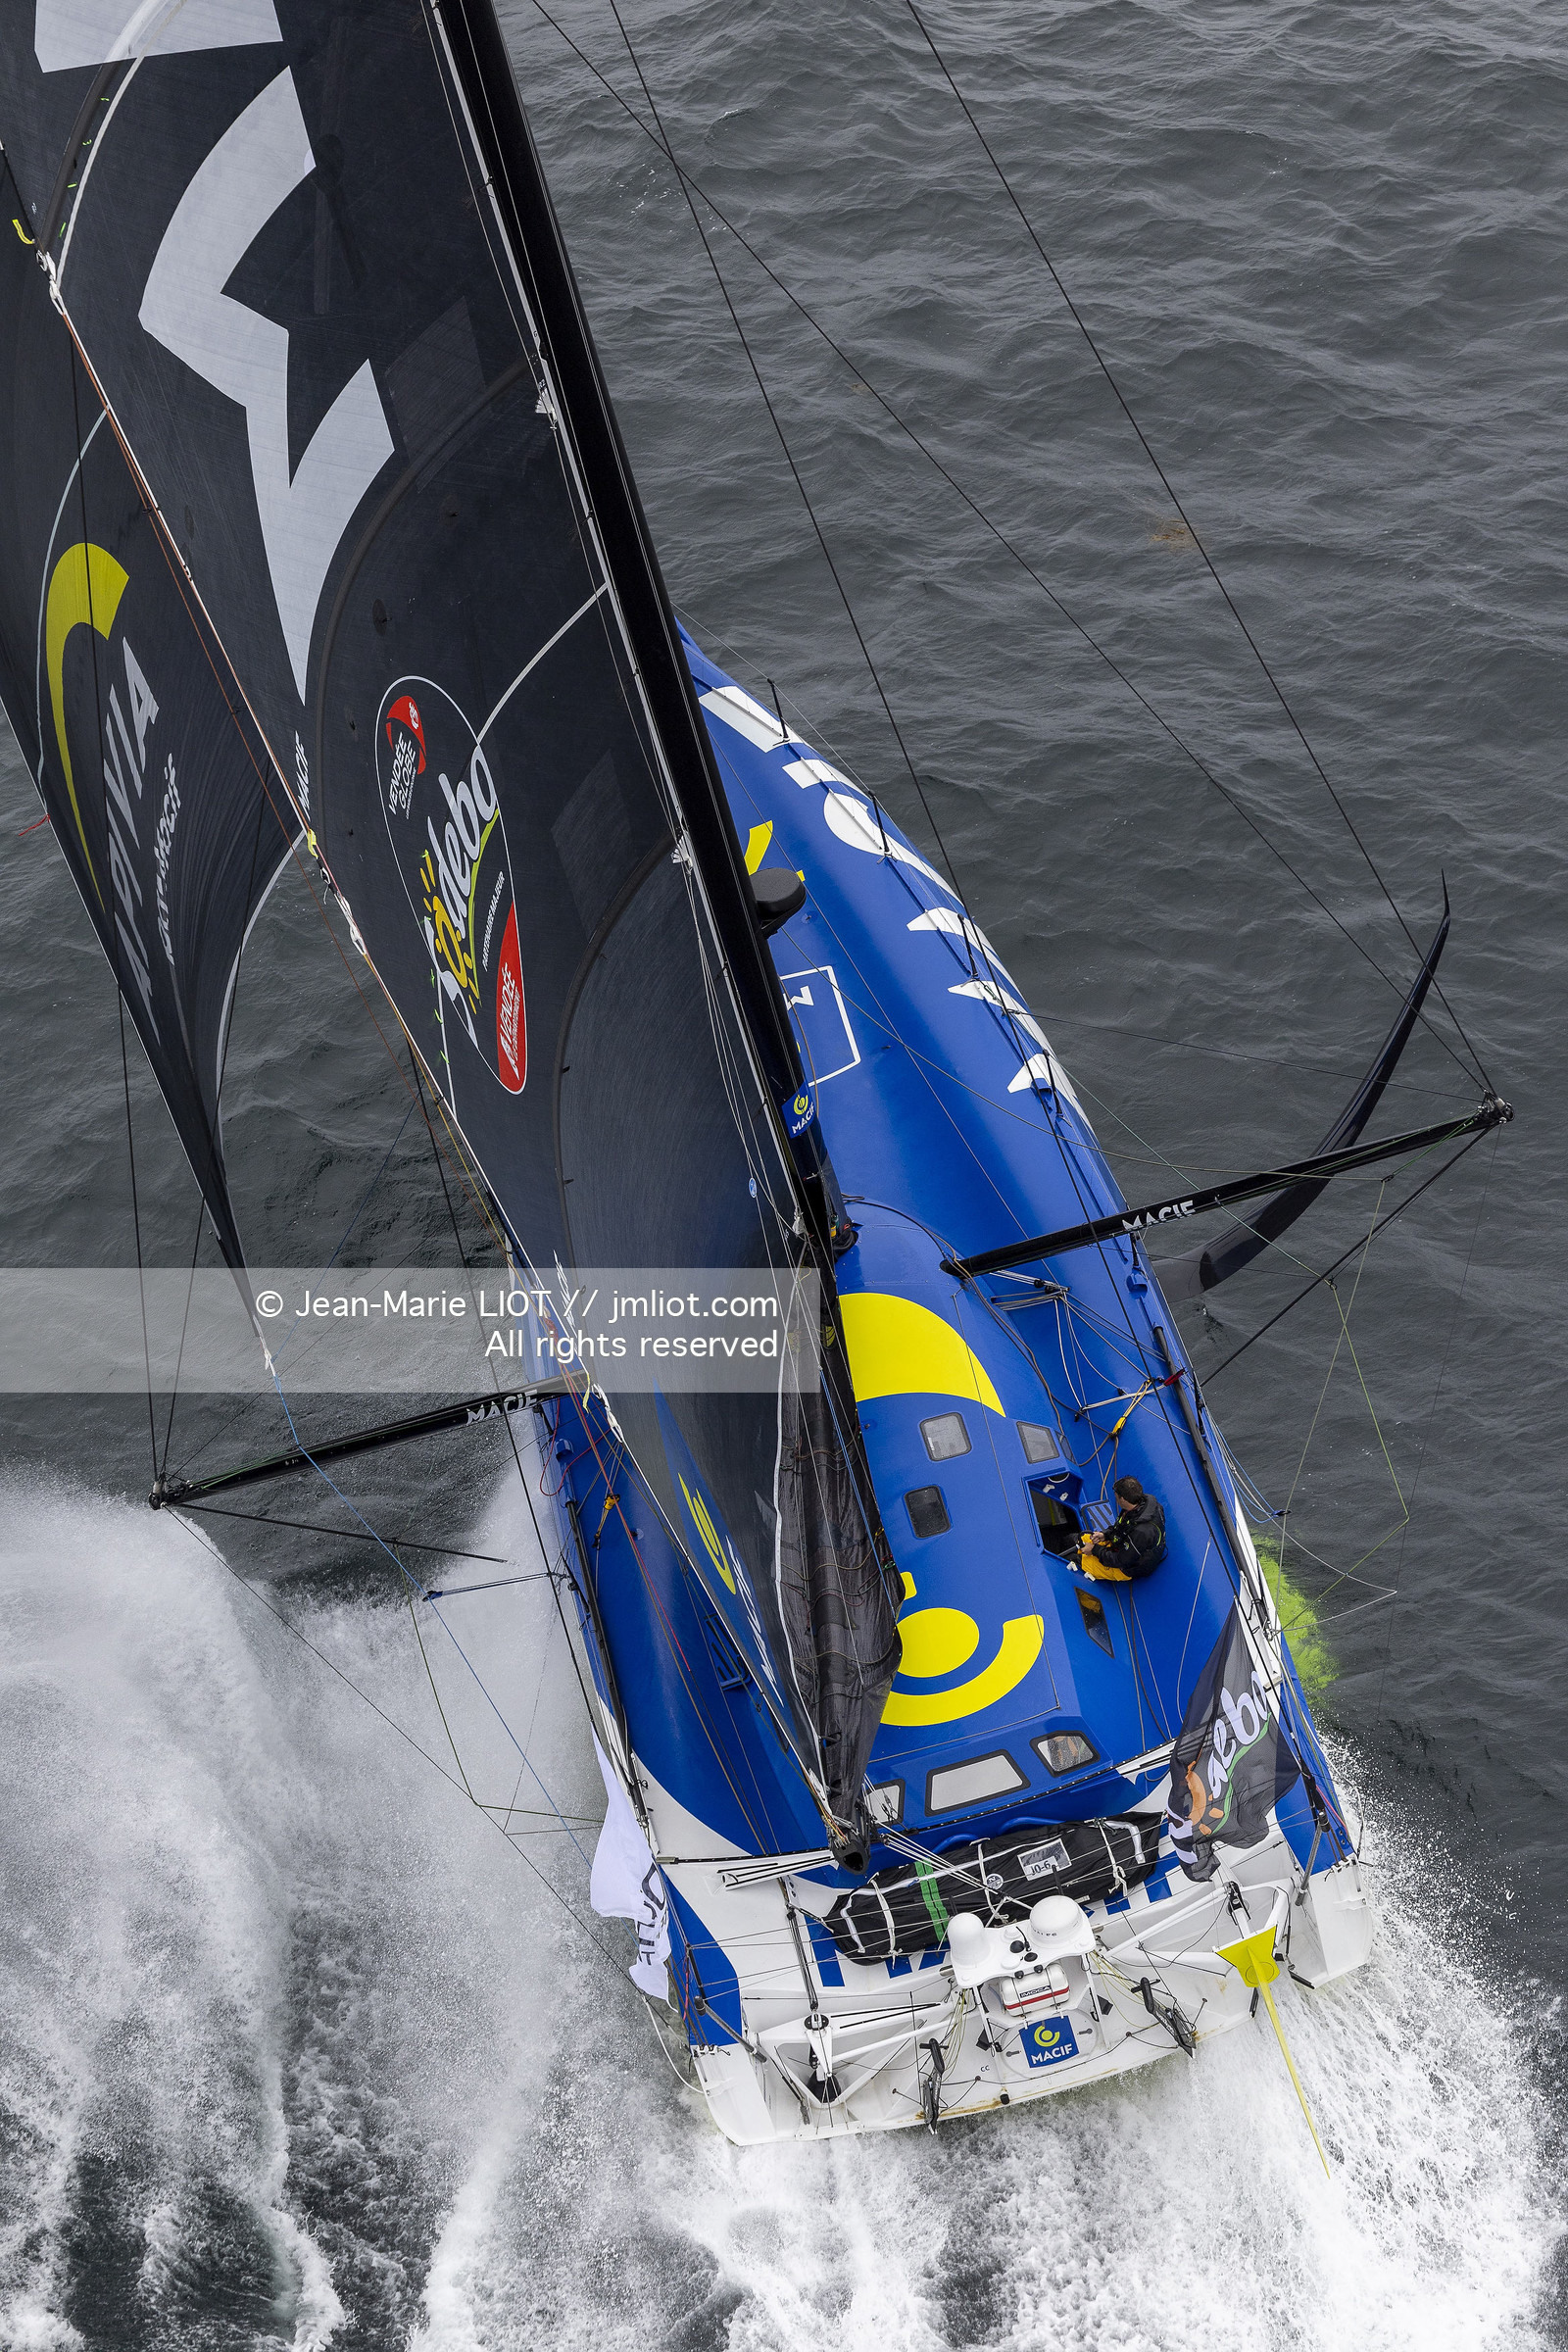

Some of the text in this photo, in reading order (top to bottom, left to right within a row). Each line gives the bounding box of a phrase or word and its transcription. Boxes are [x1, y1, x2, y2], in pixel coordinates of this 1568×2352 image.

[295, 730, 311, 822] MACIF
[399, 740, 416, 809] GLOBE
[103, 636, 160, 1047] APIVIA
[489, 869, 505, 920] MAJEUR
[791, 1100, 814, 1134] MACIF
[1122, 1200, 1196, 1233] MACIF
[466, 1389, 538, 1427] MACIF
[725, 1534, 784, 1708] MACIF
[1020, 1984, 1052, 1999] IMOCA
[1031, 2043, 1073, 2065] MACIF
